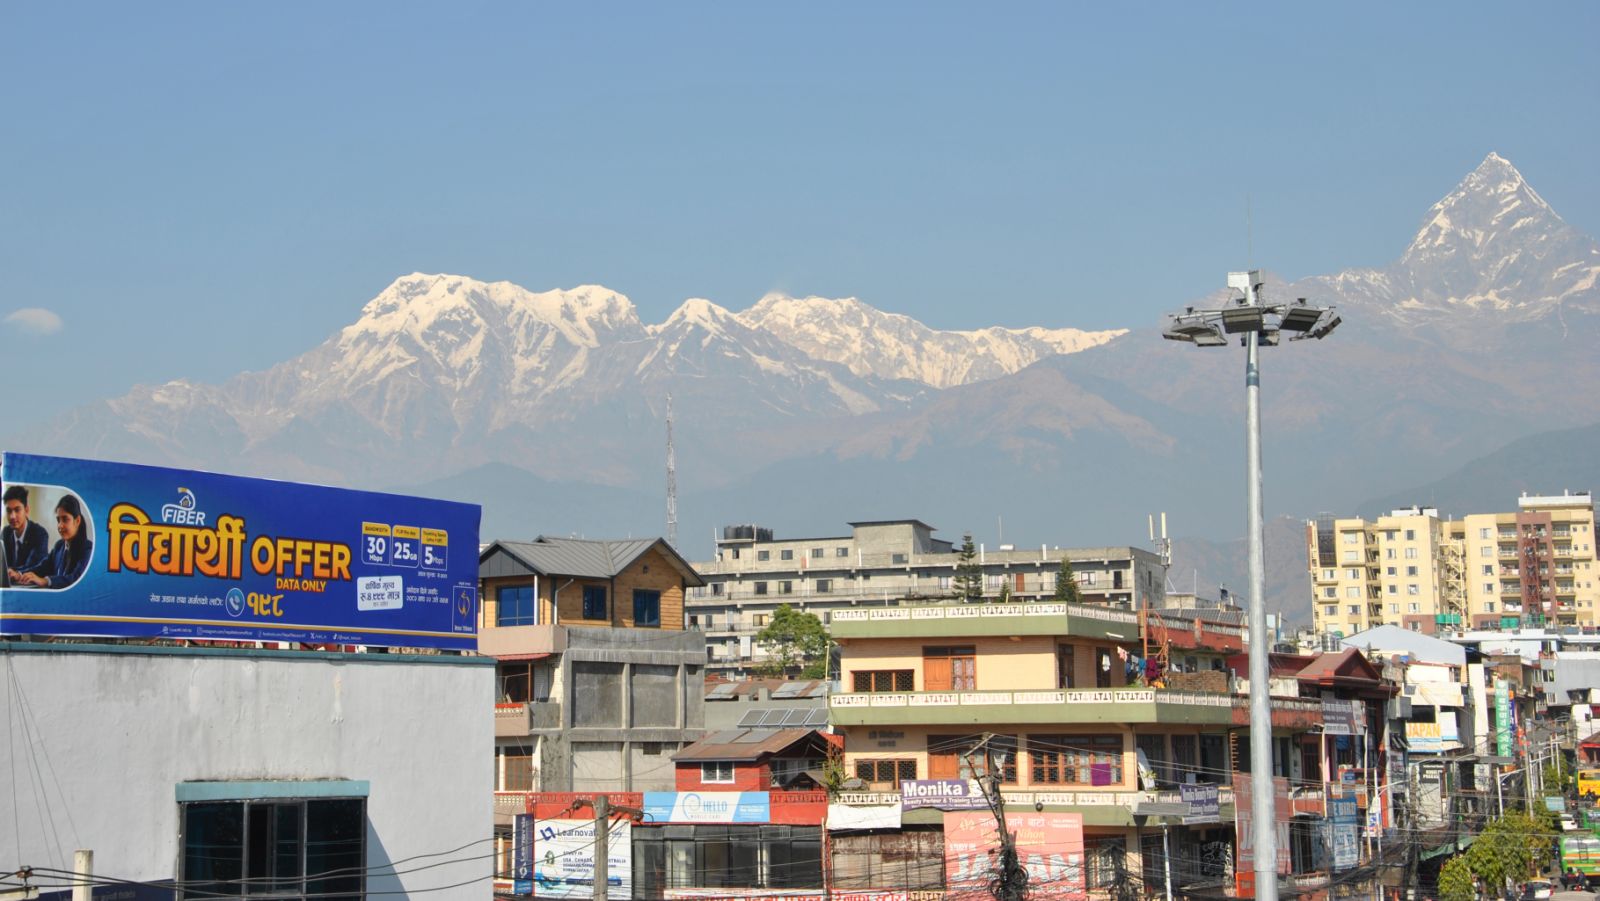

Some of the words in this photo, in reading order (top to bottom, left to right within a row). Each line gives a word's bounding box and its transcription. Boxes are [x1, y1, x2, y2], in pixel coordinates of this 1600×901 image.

[165, 508, 205, 526] FIBER
[109, 503, 246, 579] विद्यार्थी
[367, 537, 386, 555] 30
[251, 536, 351, 580] OFFER
[369, 554, 383, 562] Mbps
[276, 578, 300, 591] DATA
[301, 580, 327, 593] ONLY
[1407, 723, 1440, 737] JAPAN
[903, 782, 963, 797] Monika
[703, 801, 728, 812] HELLO
[951, 853, 1080, 883] JAAN
